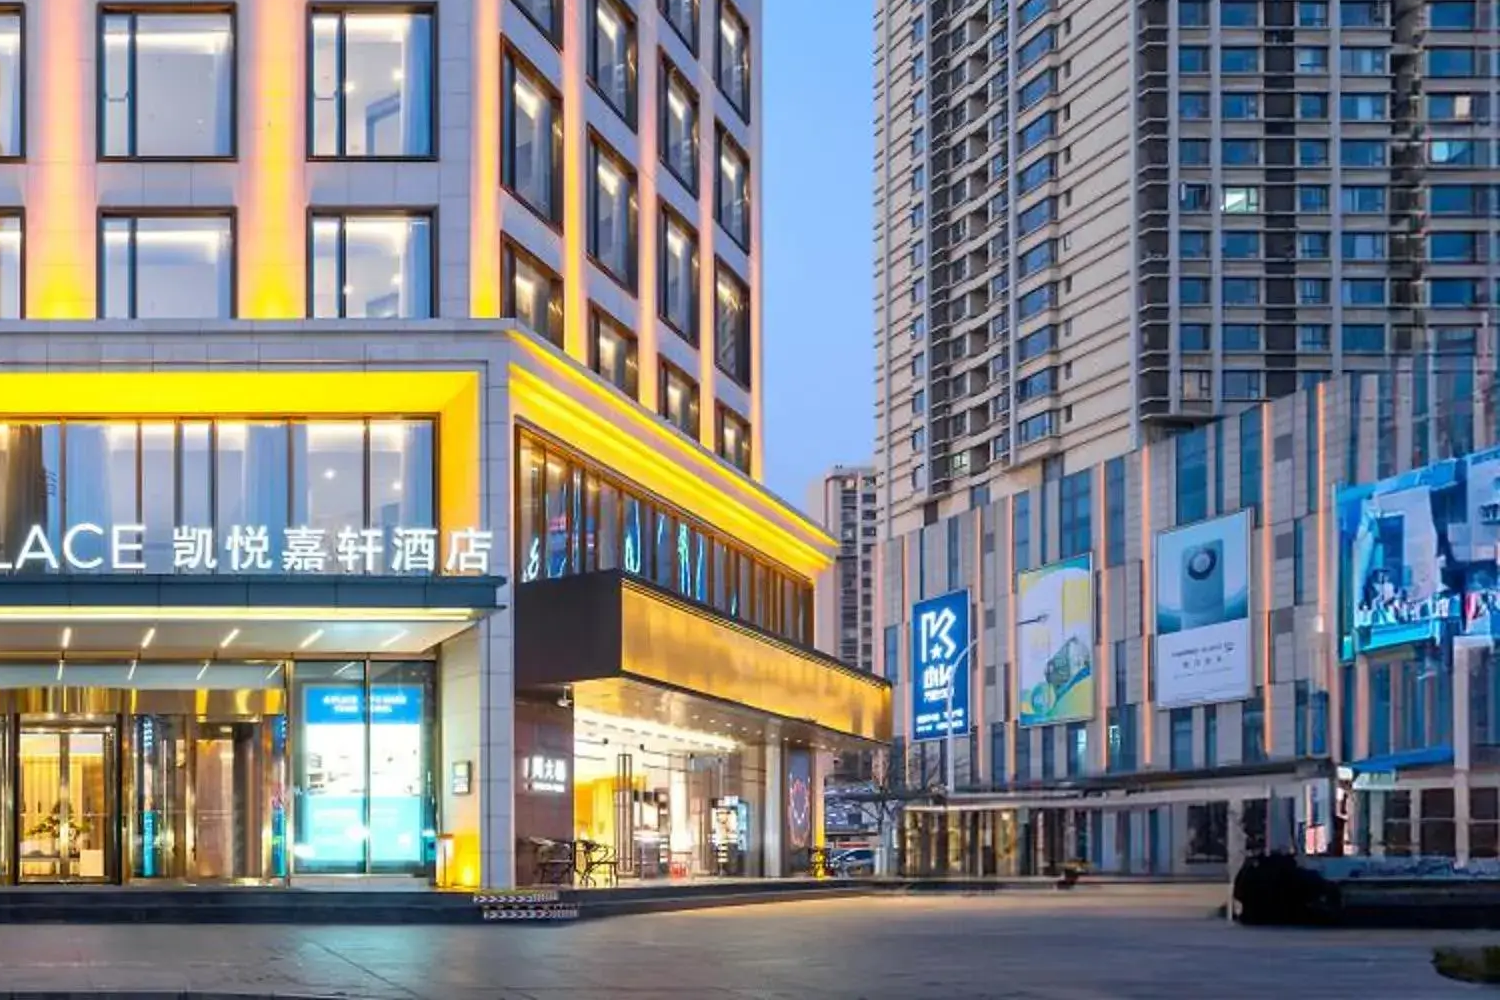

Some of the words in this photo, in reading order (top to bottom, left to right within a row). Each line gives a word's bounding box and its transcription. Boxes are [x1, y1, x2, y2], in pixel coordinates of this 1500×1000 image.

[172, 525, 494, 573] 凯悦嘉轩酒店
